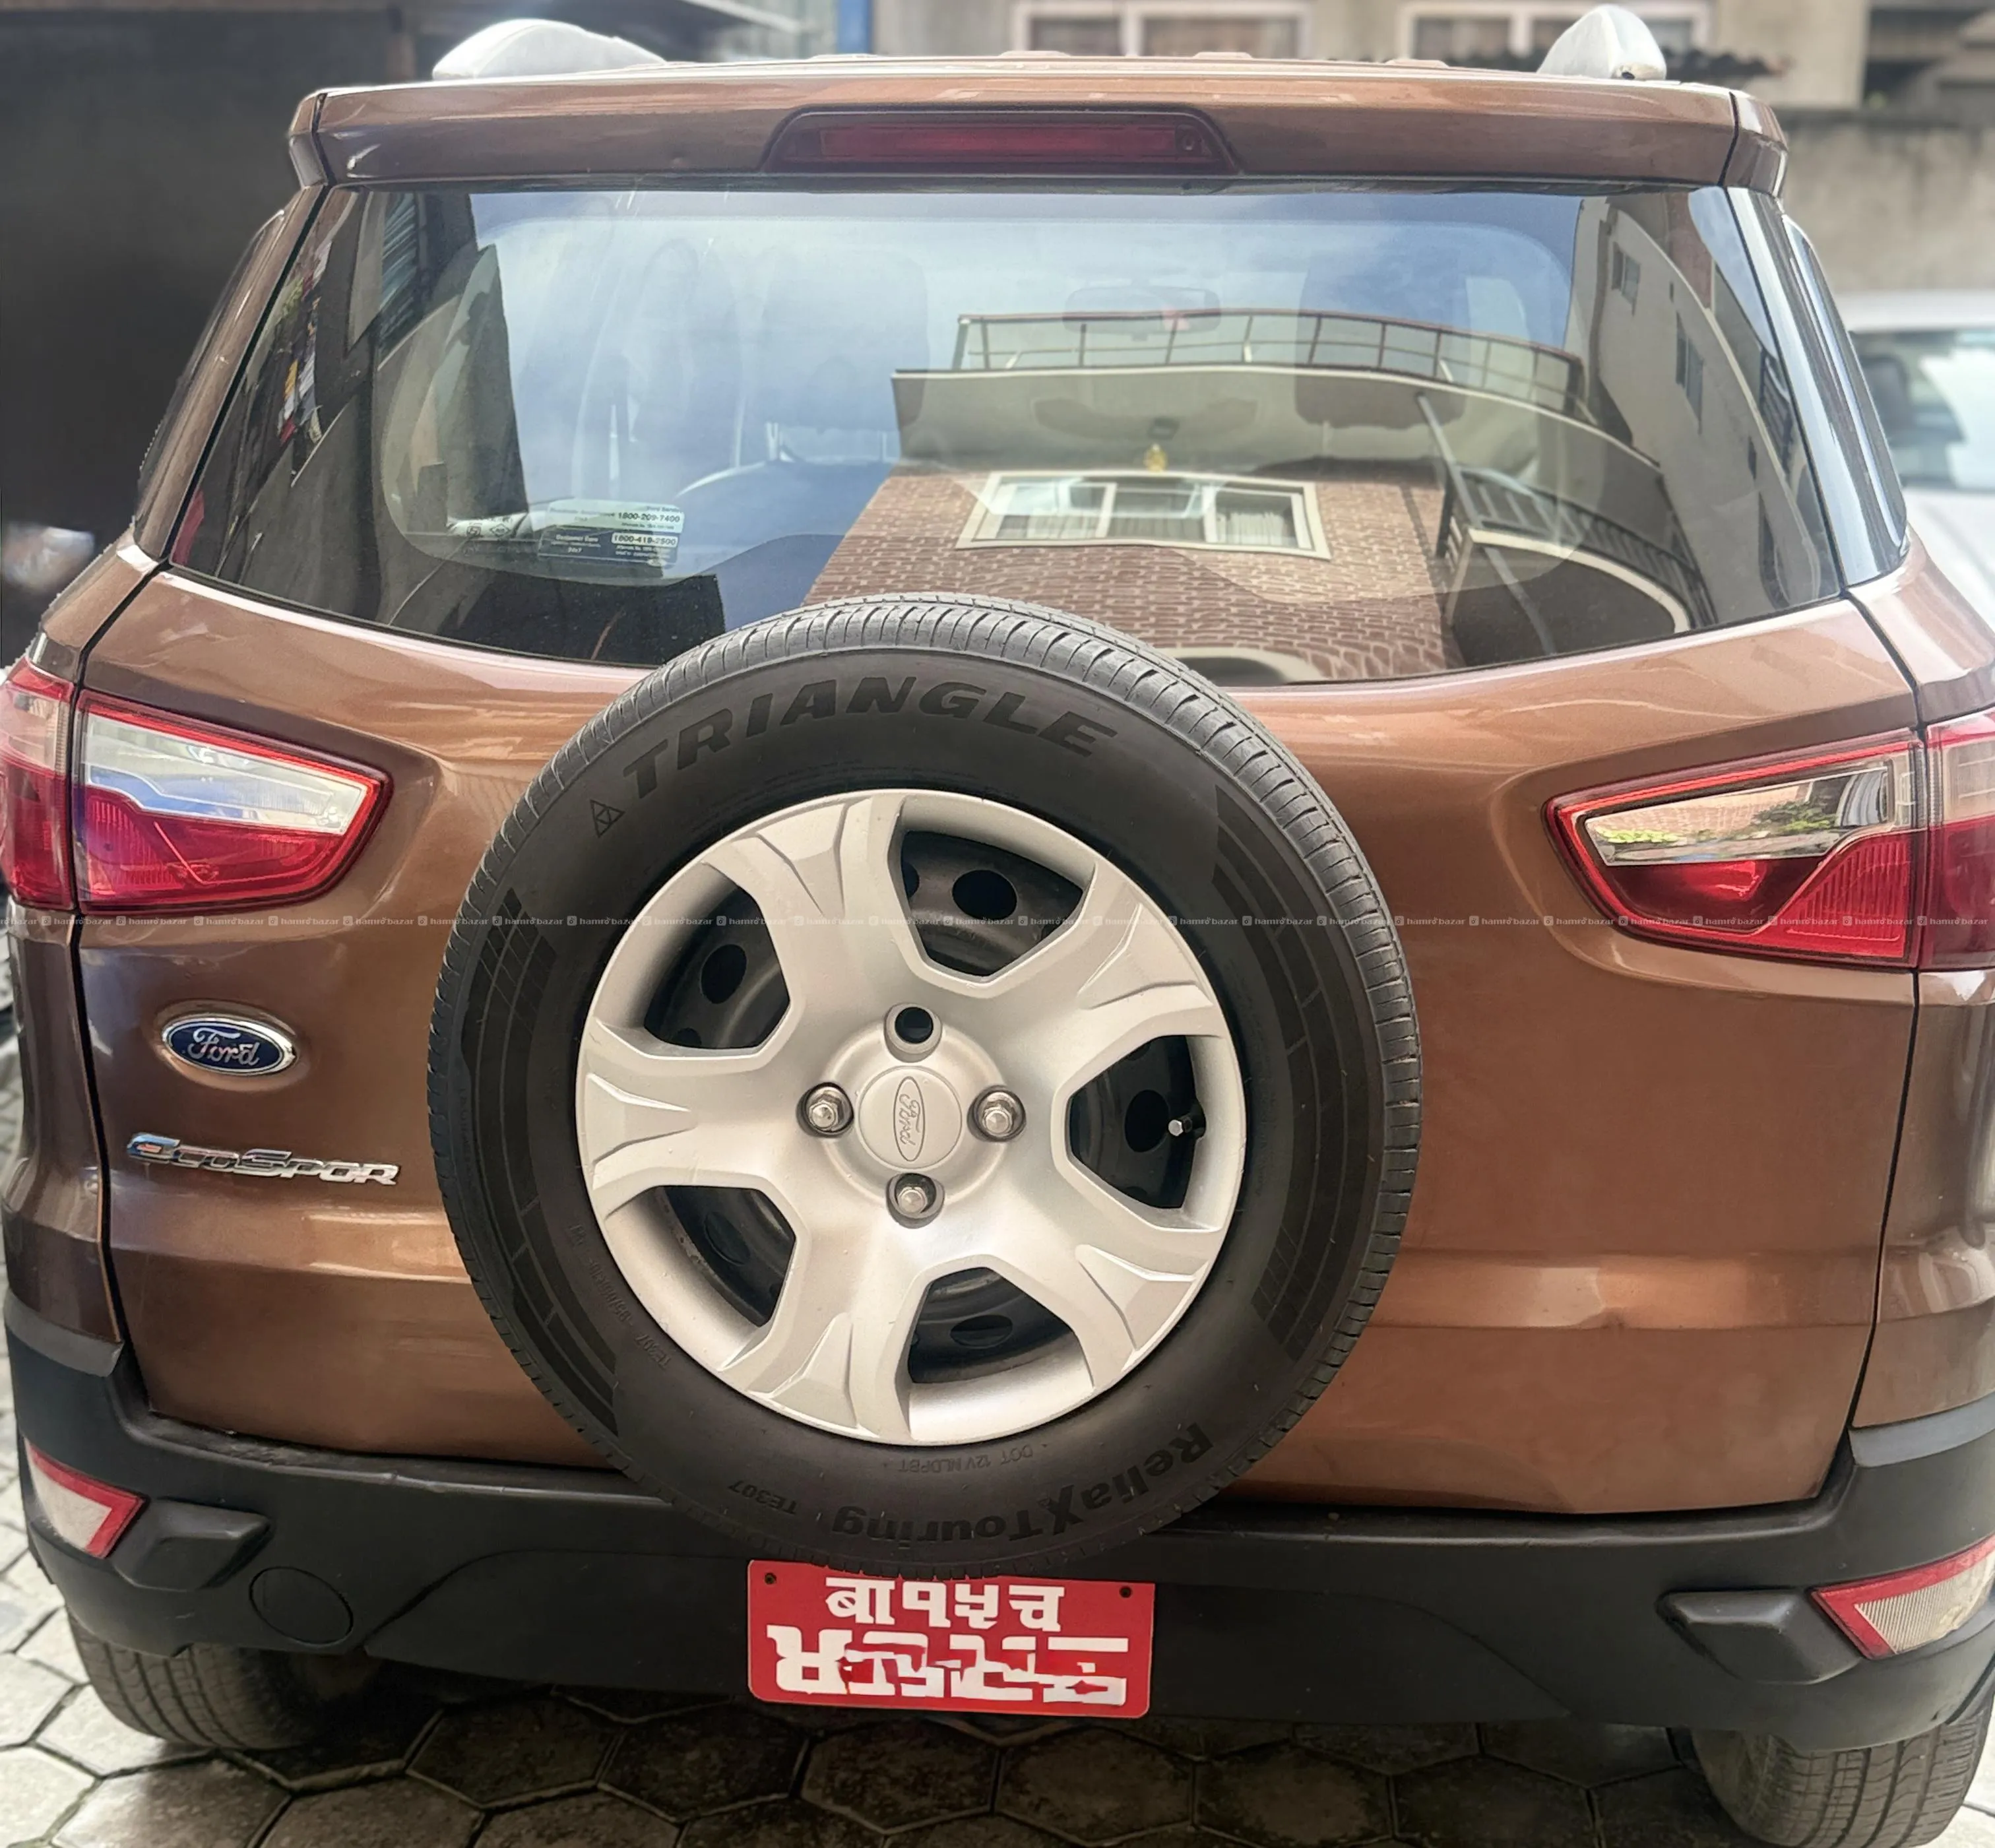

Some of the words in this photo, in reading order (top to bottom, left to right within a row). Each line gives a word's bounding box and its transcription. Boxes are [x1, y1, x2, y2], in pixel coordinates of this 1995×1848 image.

[622, 676, 1118, 799] TRIANGLE
[187, 1027, 261, 1067] Ford
[899, 1094, 920, 1146] Ford
[1001, 1444, 1034, 1465] DOT
[728, 1480, 797, 1515] TE307
